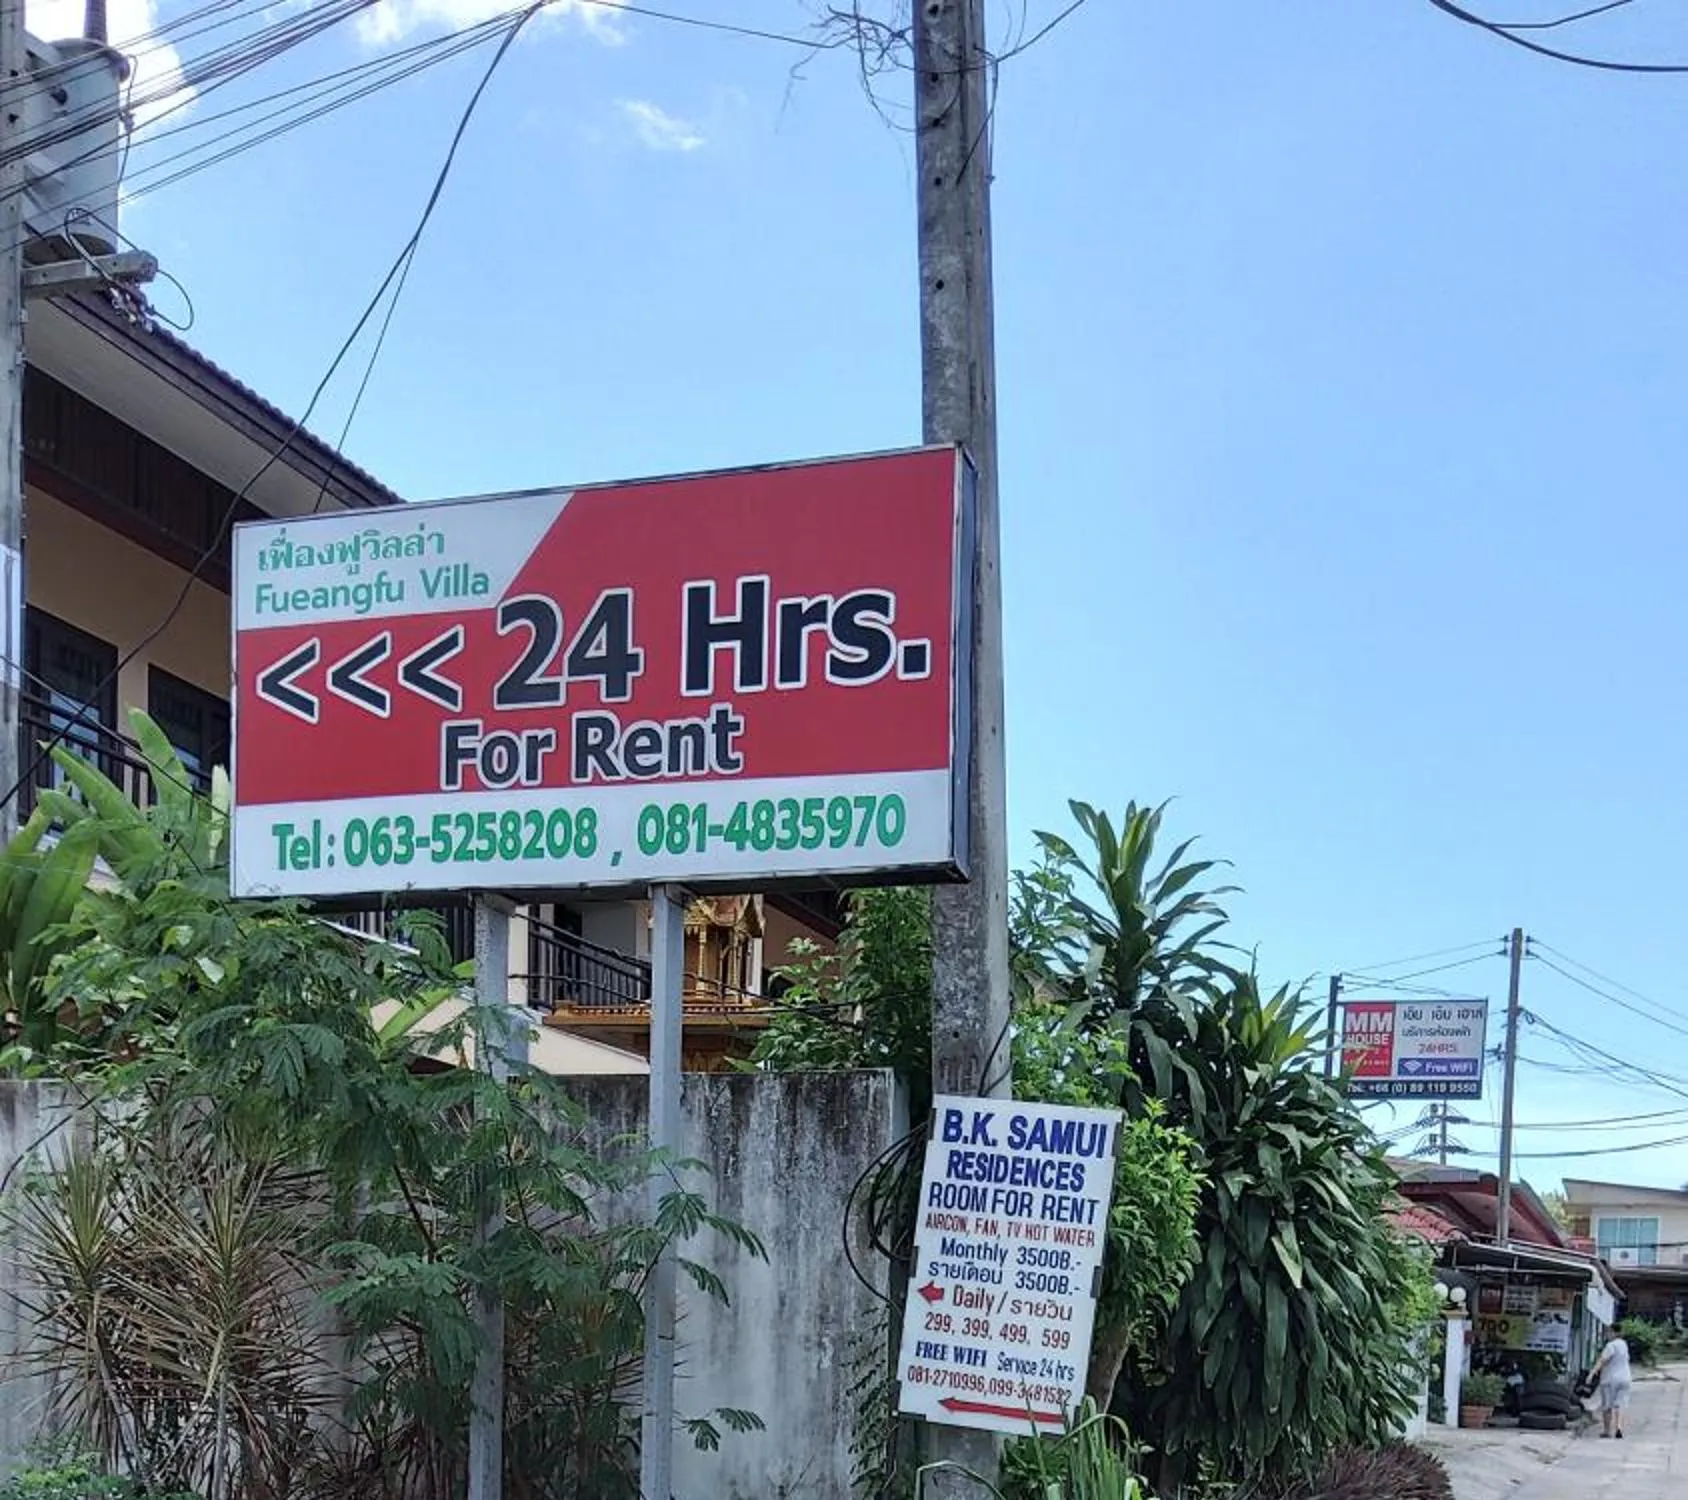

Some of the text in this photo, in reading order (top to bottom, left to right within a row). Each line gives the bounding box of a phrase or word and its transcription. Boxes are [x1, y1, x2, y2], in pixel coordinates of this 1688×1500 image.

[258, 523, 445, 576] เฟื่องฟูวิลล่า
[255, 563, 490, 614] Fueangfu Villa
[494, 575, 931, 709] 24 Hrs.
[441, 704, 743, 790] For Rent
[344, 807, 597, 866] 063-5258208
[637, 795, 905, 855] 081-4835970
[1346, 1011, 1392, 1033] MM
[1347, 1033, 1390, 1045] HOUSE
[1425, 1062, 1448, 1073] Free
[942, 1109, 1107, 1158] B.K. SAMUI
[946, 1150, 1085, 1192] RESIDENCES
[928, 1182, 1100, 1225] ROOM FOR RENT
[941, 1237, 1009, 1266] Monthly
[1007, 1222, 1022, 1239] TV
[1025, 1224, 1049, 1242] HOT
[1053, 1226, 1095, 1248] WATER
[952, 1284, 995, 1316] Daily
[1041, 1329, 1071, 1350] 599
[915, 1341, 1075, 1381] FREE WIFI Service 24 hrs
